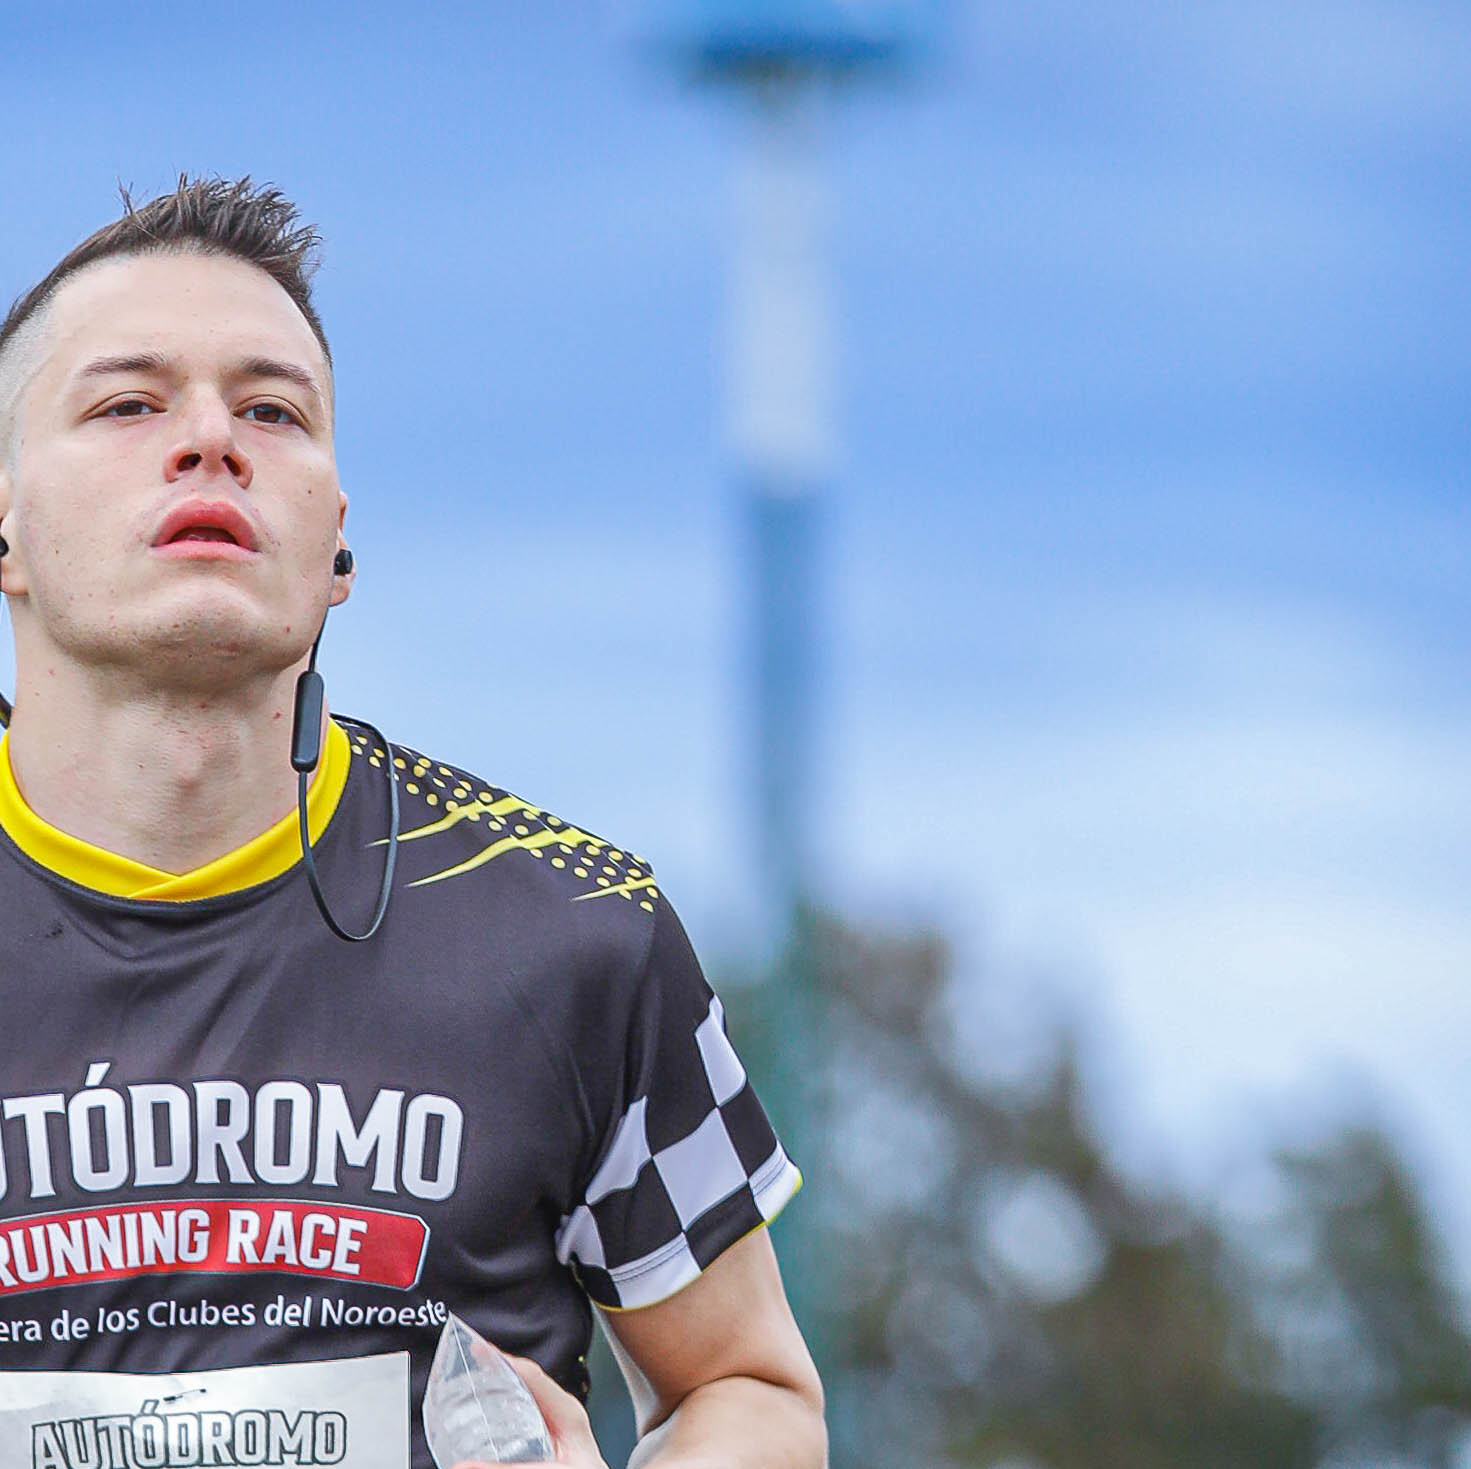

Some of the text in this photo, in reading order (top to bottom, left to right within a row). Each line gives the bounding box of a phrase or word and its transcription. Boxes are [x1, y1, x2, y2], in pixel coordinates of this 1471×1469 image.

[225, 1208, 368, 1276] RACE
[50, 1309, 90, 1341] de
[97, 1306, 140, 1333] los
[146, 1300, 255, 1327] Clubes
[264, 1295, 312, 1327] del
[320, 1297, 447, 1327] Noroeste
